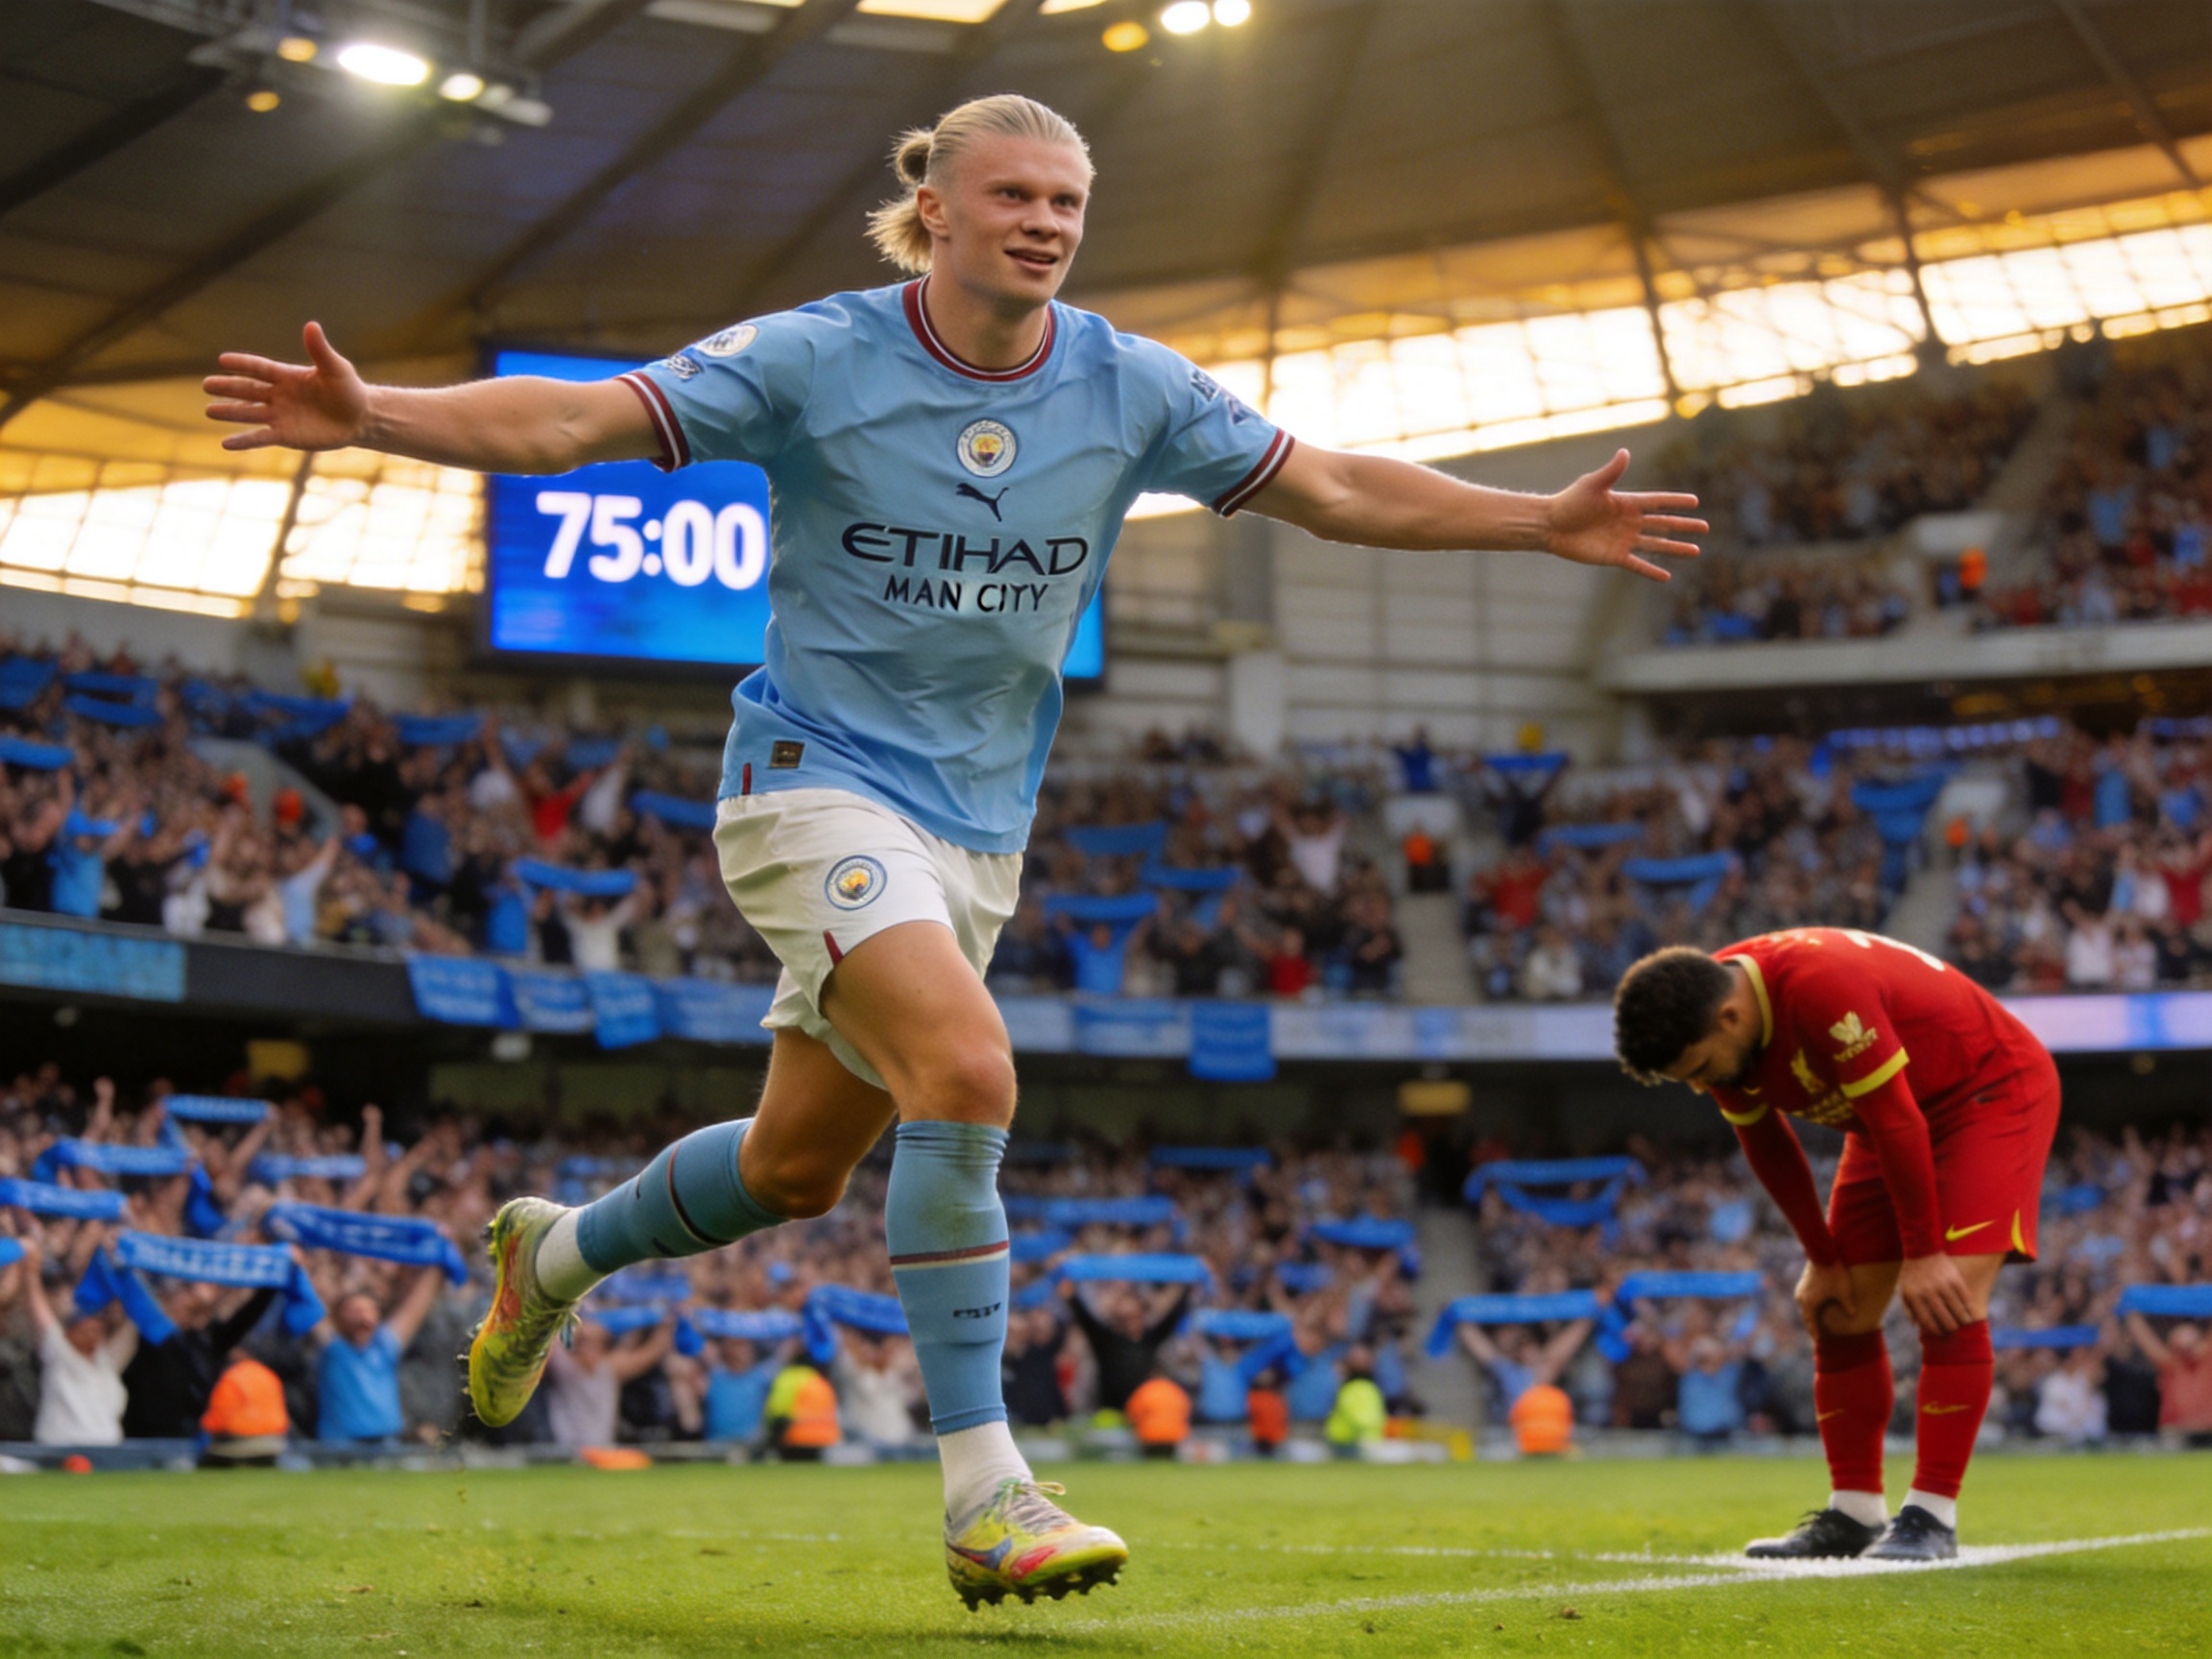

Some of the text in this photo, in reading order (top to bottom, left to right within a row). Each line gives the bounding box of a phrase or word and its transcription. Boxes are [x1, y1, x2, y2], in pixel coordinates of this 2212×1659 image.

[536, 491, 767, 590] 75:00
[841, 521, 1089, 576] ETIHAD
[883, 574, 1048, 613] MAN CITY
